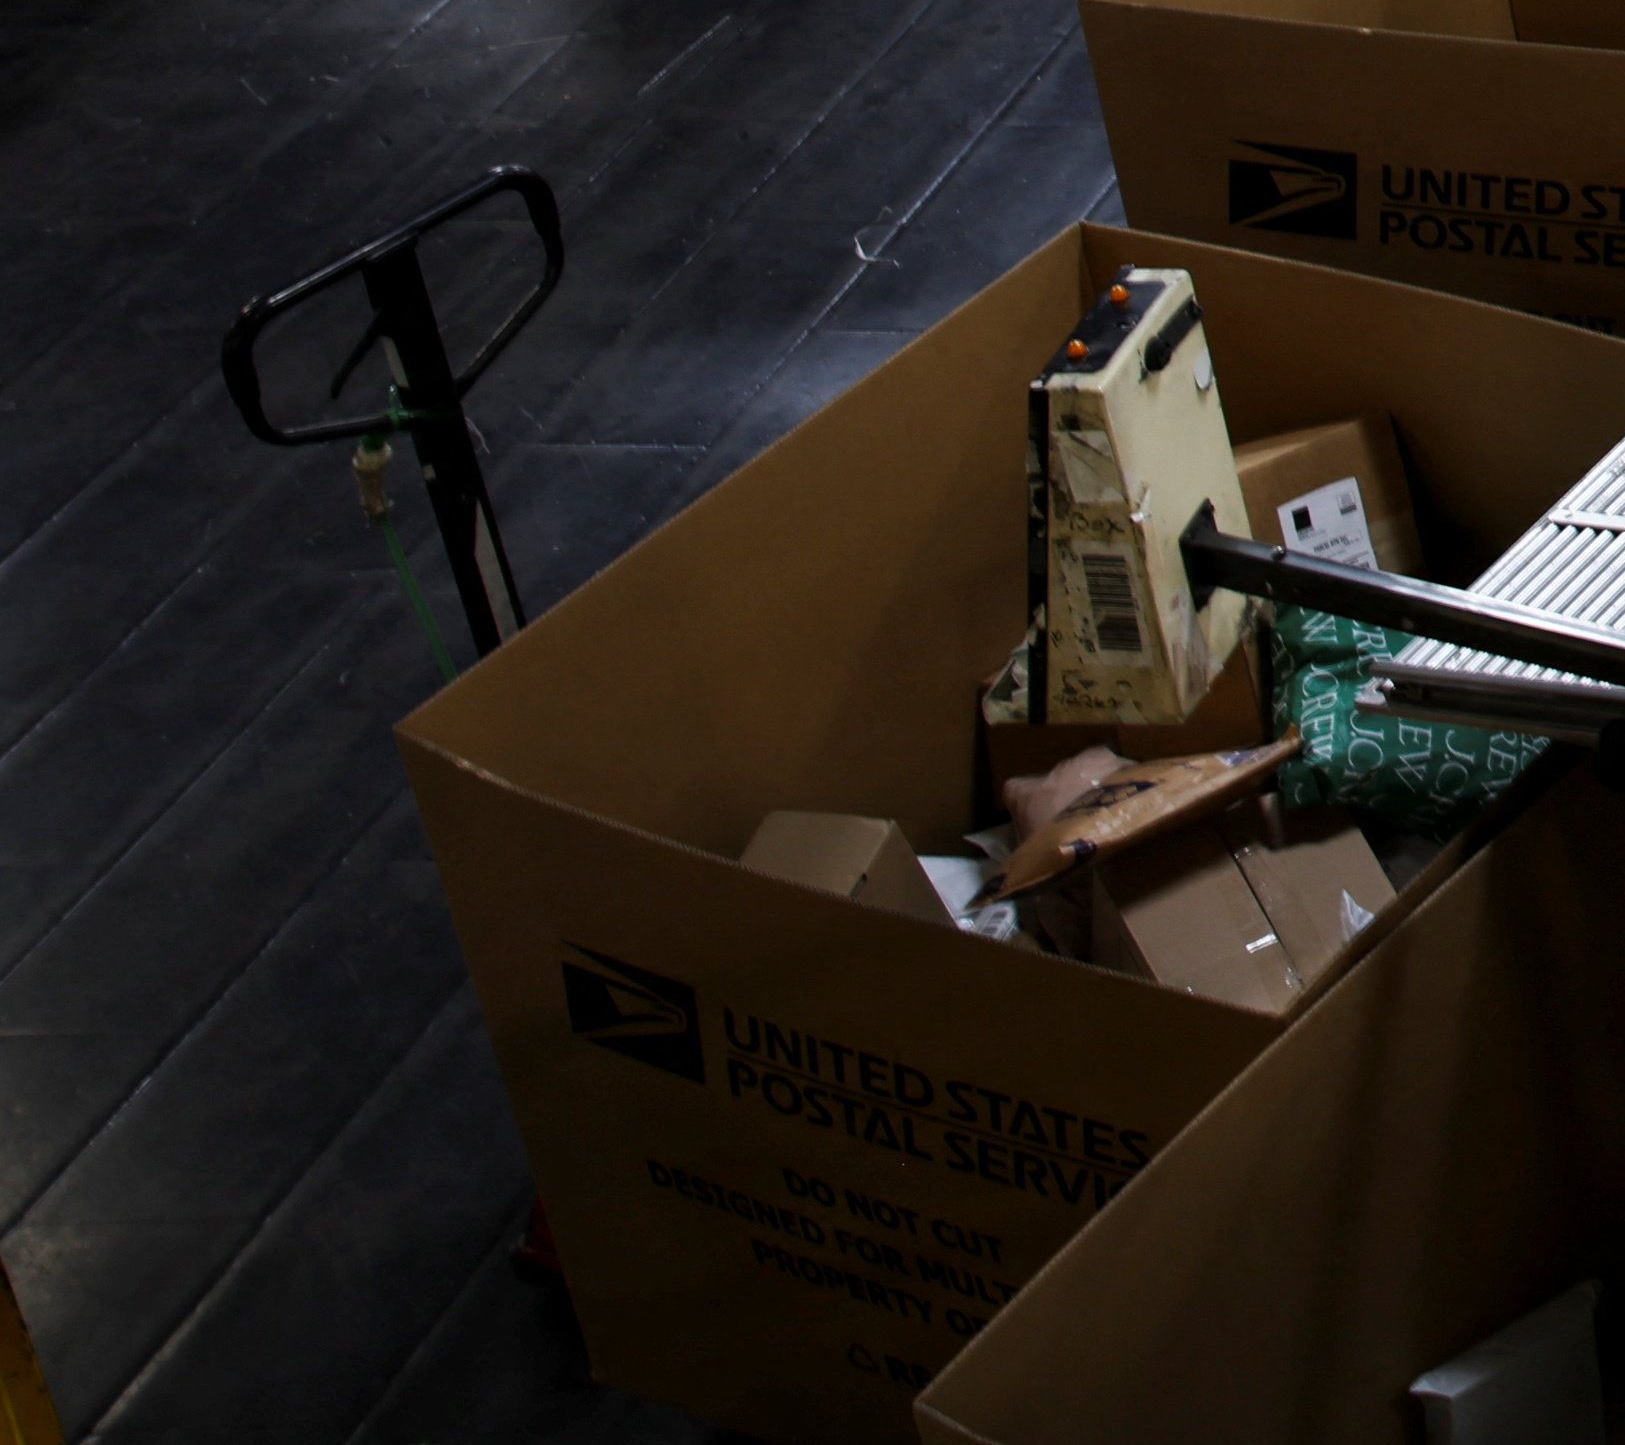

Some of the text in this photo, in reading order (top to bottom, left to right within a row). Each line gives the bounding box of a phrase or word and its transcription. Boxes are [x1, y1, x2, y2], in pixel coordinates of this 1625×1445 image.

[1379, 210, 1562, 263] POSTAL
[1380, 164, 1570, 216] UNITED
[723, 1007, 1150, 1170] UNITED STATES
[727, 1057, 933, 1162] POSTAL
[646, 1159, 1019, 1305] DESIGNED FOR MULT
[782, 1168, 1002, 1263] DO NOT CUT
[751, 1238, 932, 1324] PROPERTY
